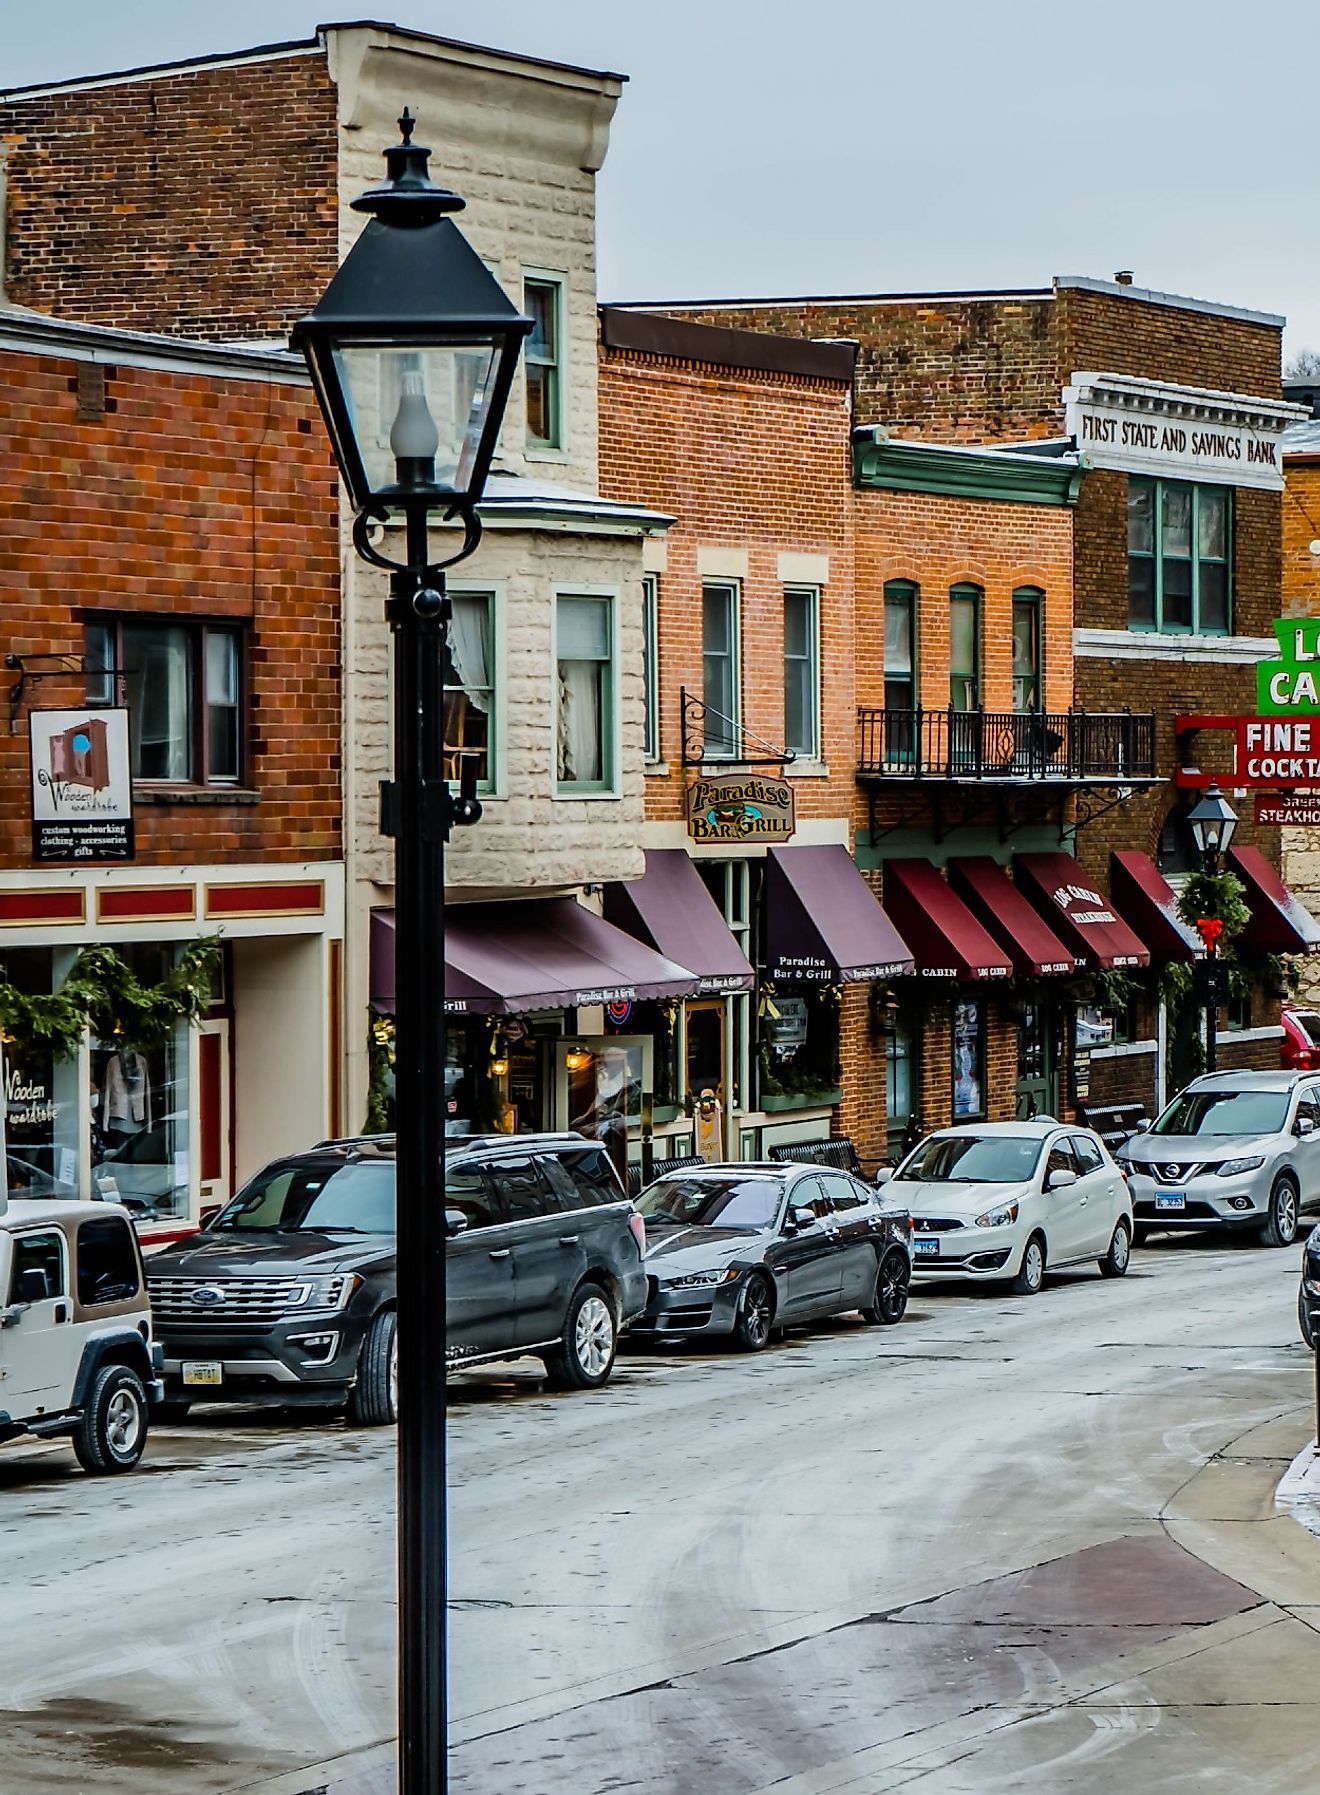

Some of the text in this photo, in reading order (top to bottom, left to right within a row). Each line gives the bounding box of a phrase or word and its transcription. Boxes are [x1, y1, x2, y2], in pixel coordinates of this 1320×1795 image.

[1082, 414, 1276, 465] FIRST STATE AND SAVINGS BANK
[1246, 723, 1311, 752] FINE
[692, 780, 790, 812] Paradise
[42, 824, 126, 835] custom woodworking
[691, 817, 730, 838] BAR
[736, 814, 792, 835] GRILL
[40, 836, 74, 846] clothing
[80, 835, 127, 845] accessories
[74, 846, 93, 857] gifts
[1053, 887, 1073, 909] LOG
[779, 956, 825, 966] Paradise
[774, 968, 831, 979] Bar & Grill
[922, 968, 958, 977] CABIN
